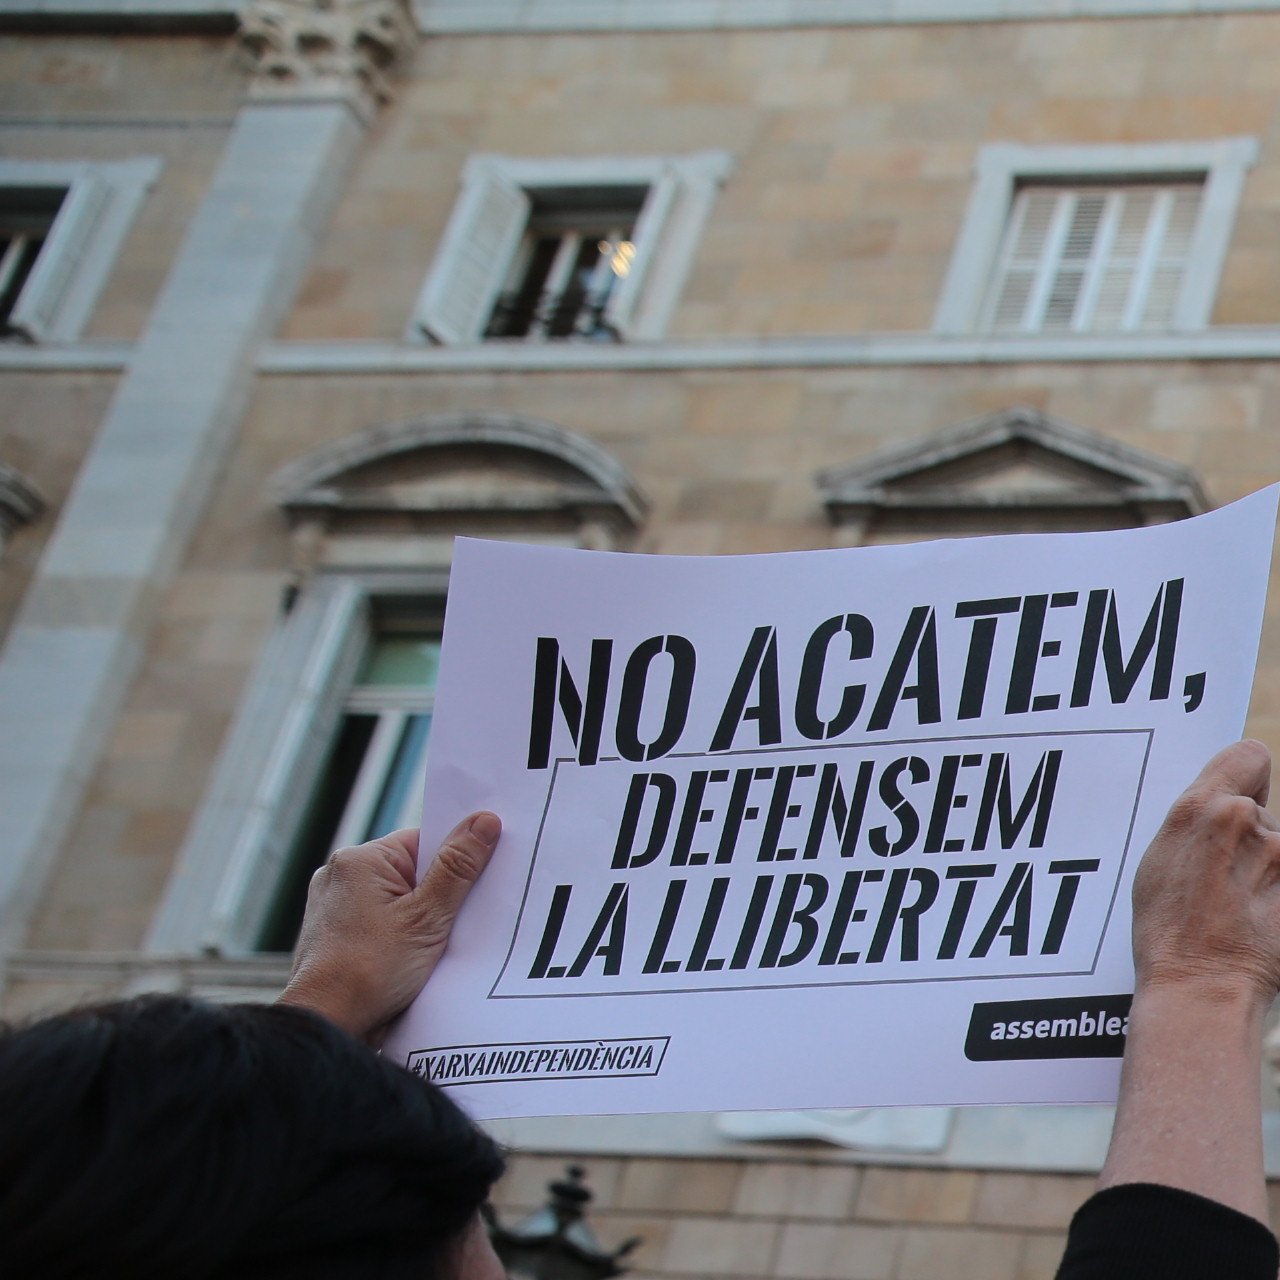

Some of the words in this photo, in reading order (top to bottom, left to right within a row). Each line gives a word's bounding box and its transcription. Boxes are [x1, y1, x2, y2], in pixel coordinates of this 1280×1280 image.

[527, 634, 697, 769] NO
[710, 577, 1207, 752] ACATEM,
[610, 750, 1063, 870] DEFENSEM
[527, 883, 630, 979] LA
[641, 859, 1100, 974] LLIBERTAT
